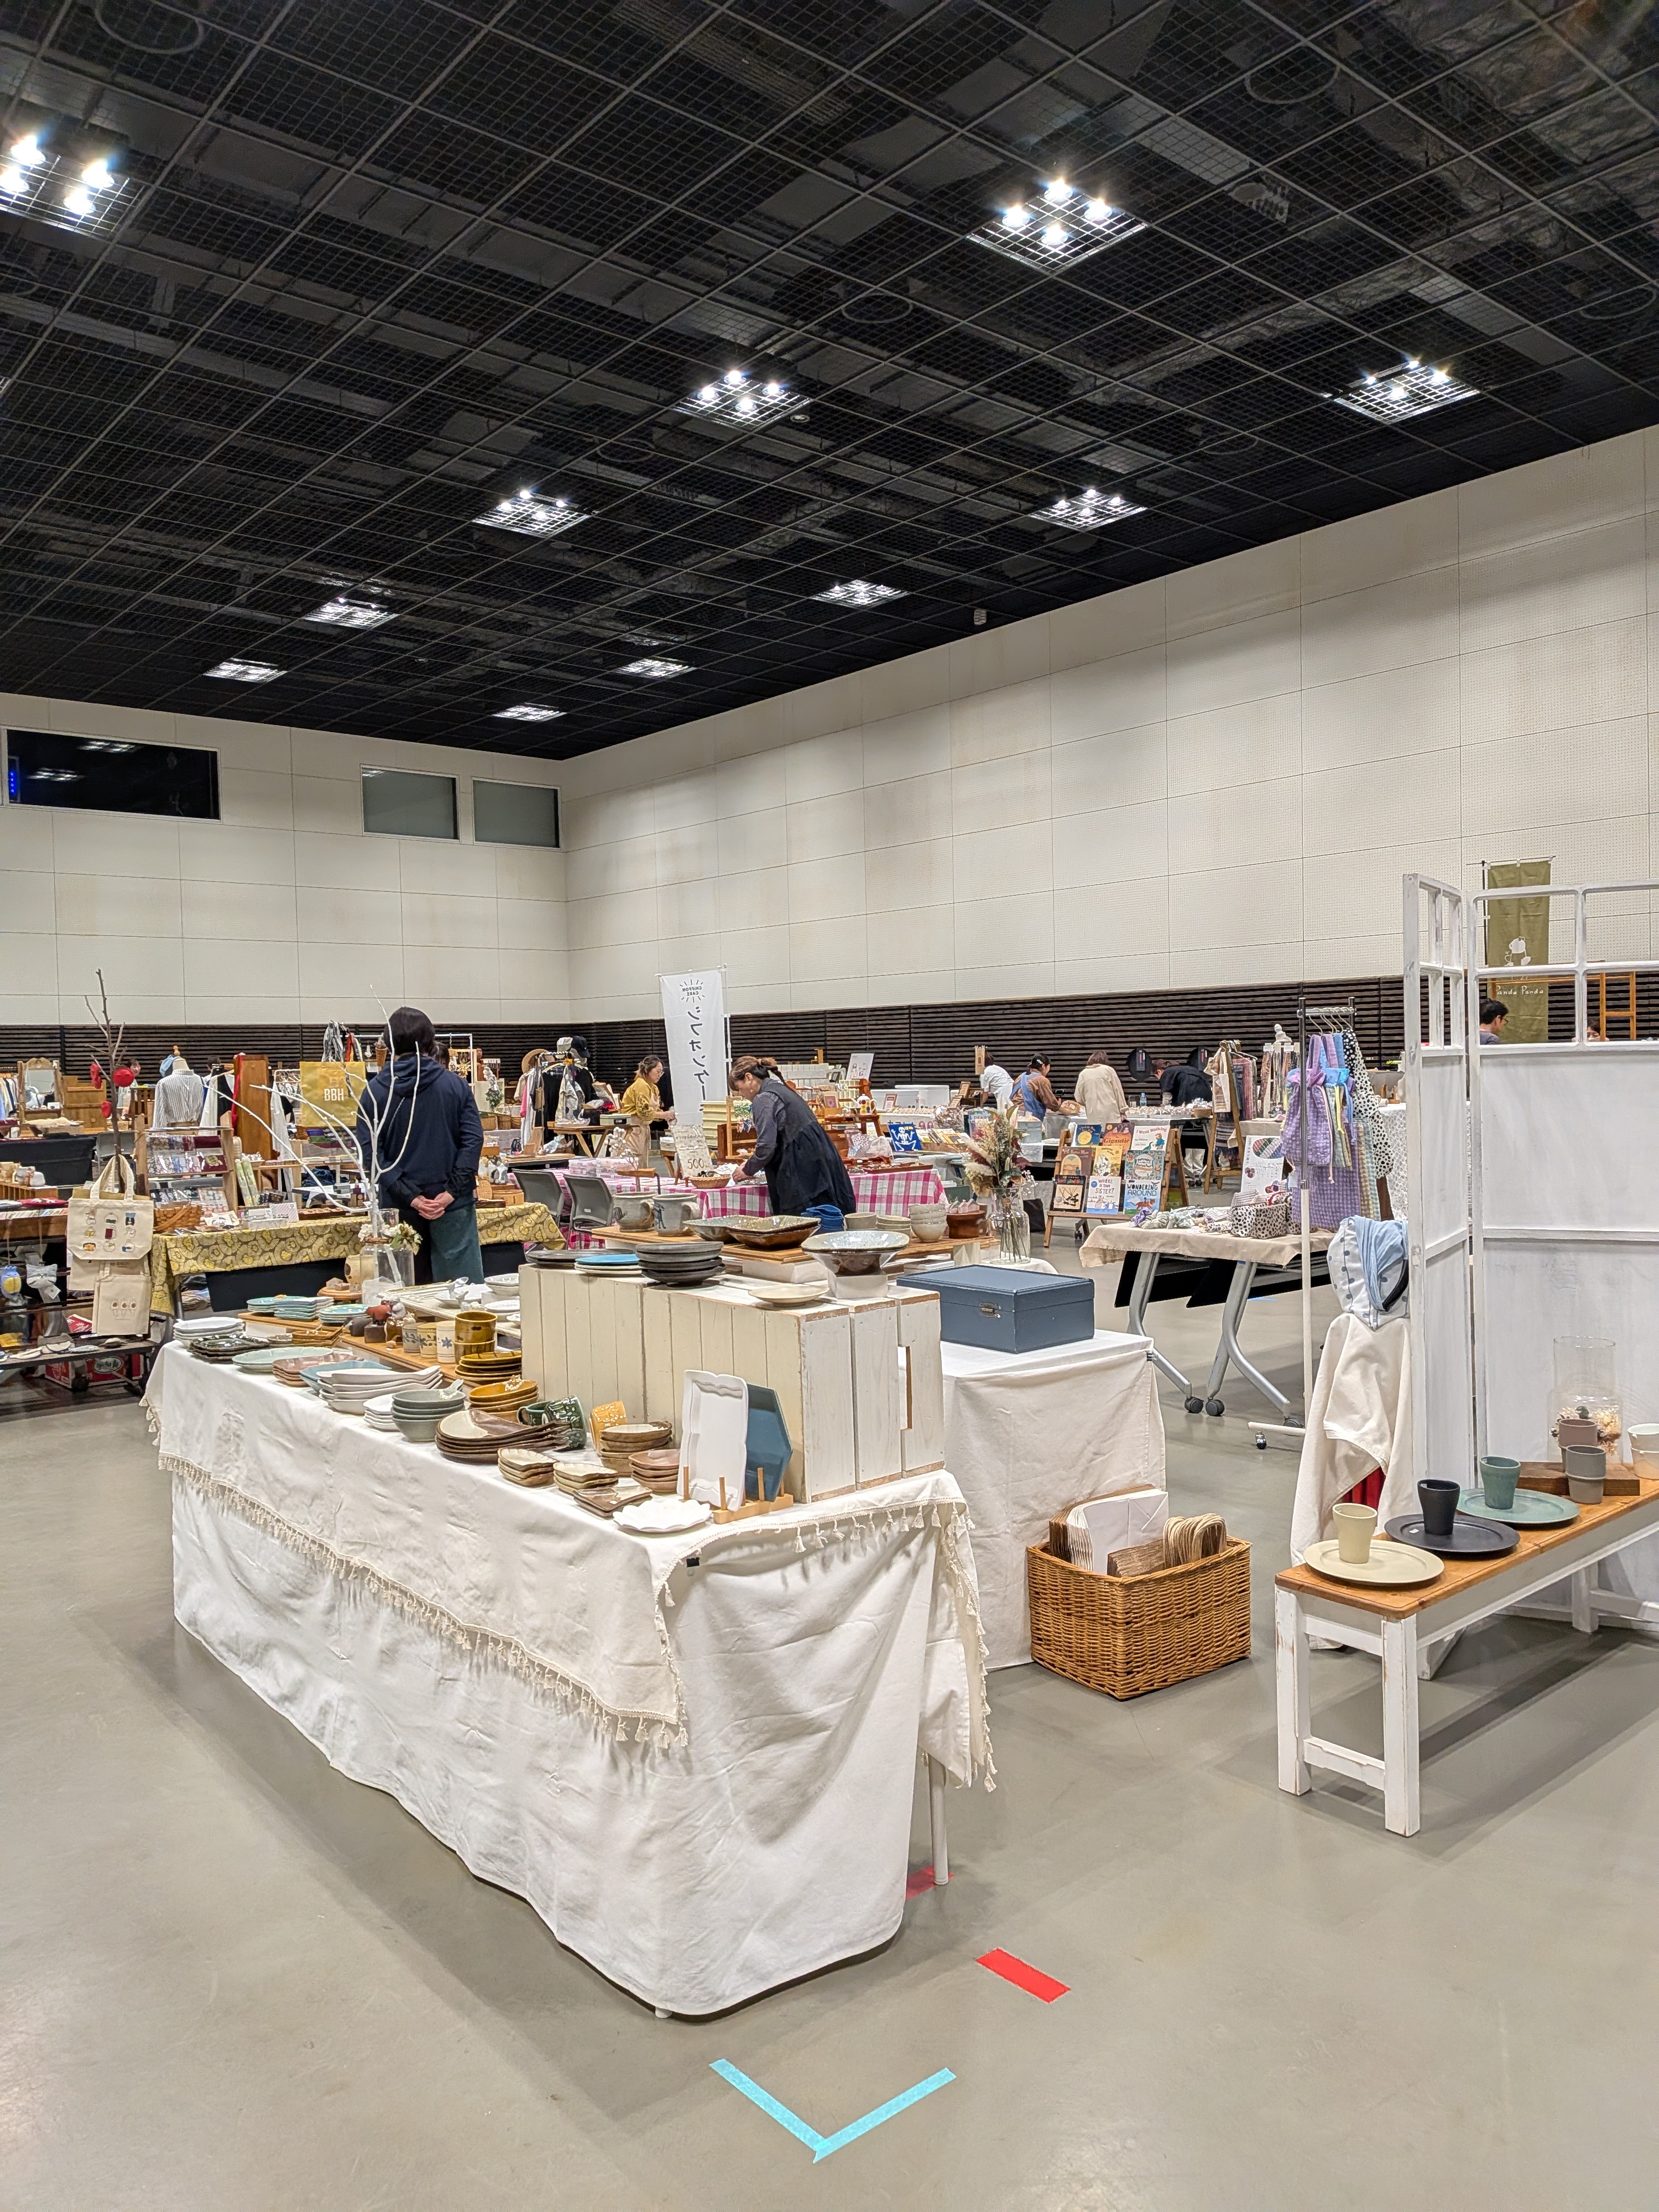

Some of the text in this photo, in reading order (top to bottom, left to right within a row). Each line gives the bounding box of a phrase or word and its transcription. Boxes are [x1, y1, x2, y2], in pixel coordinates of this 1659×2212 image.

[1521, 985, 1544, 994] Panda
[324, 1088, 344, 1101] BBH
[687, 1158, 704, 1170] 500
